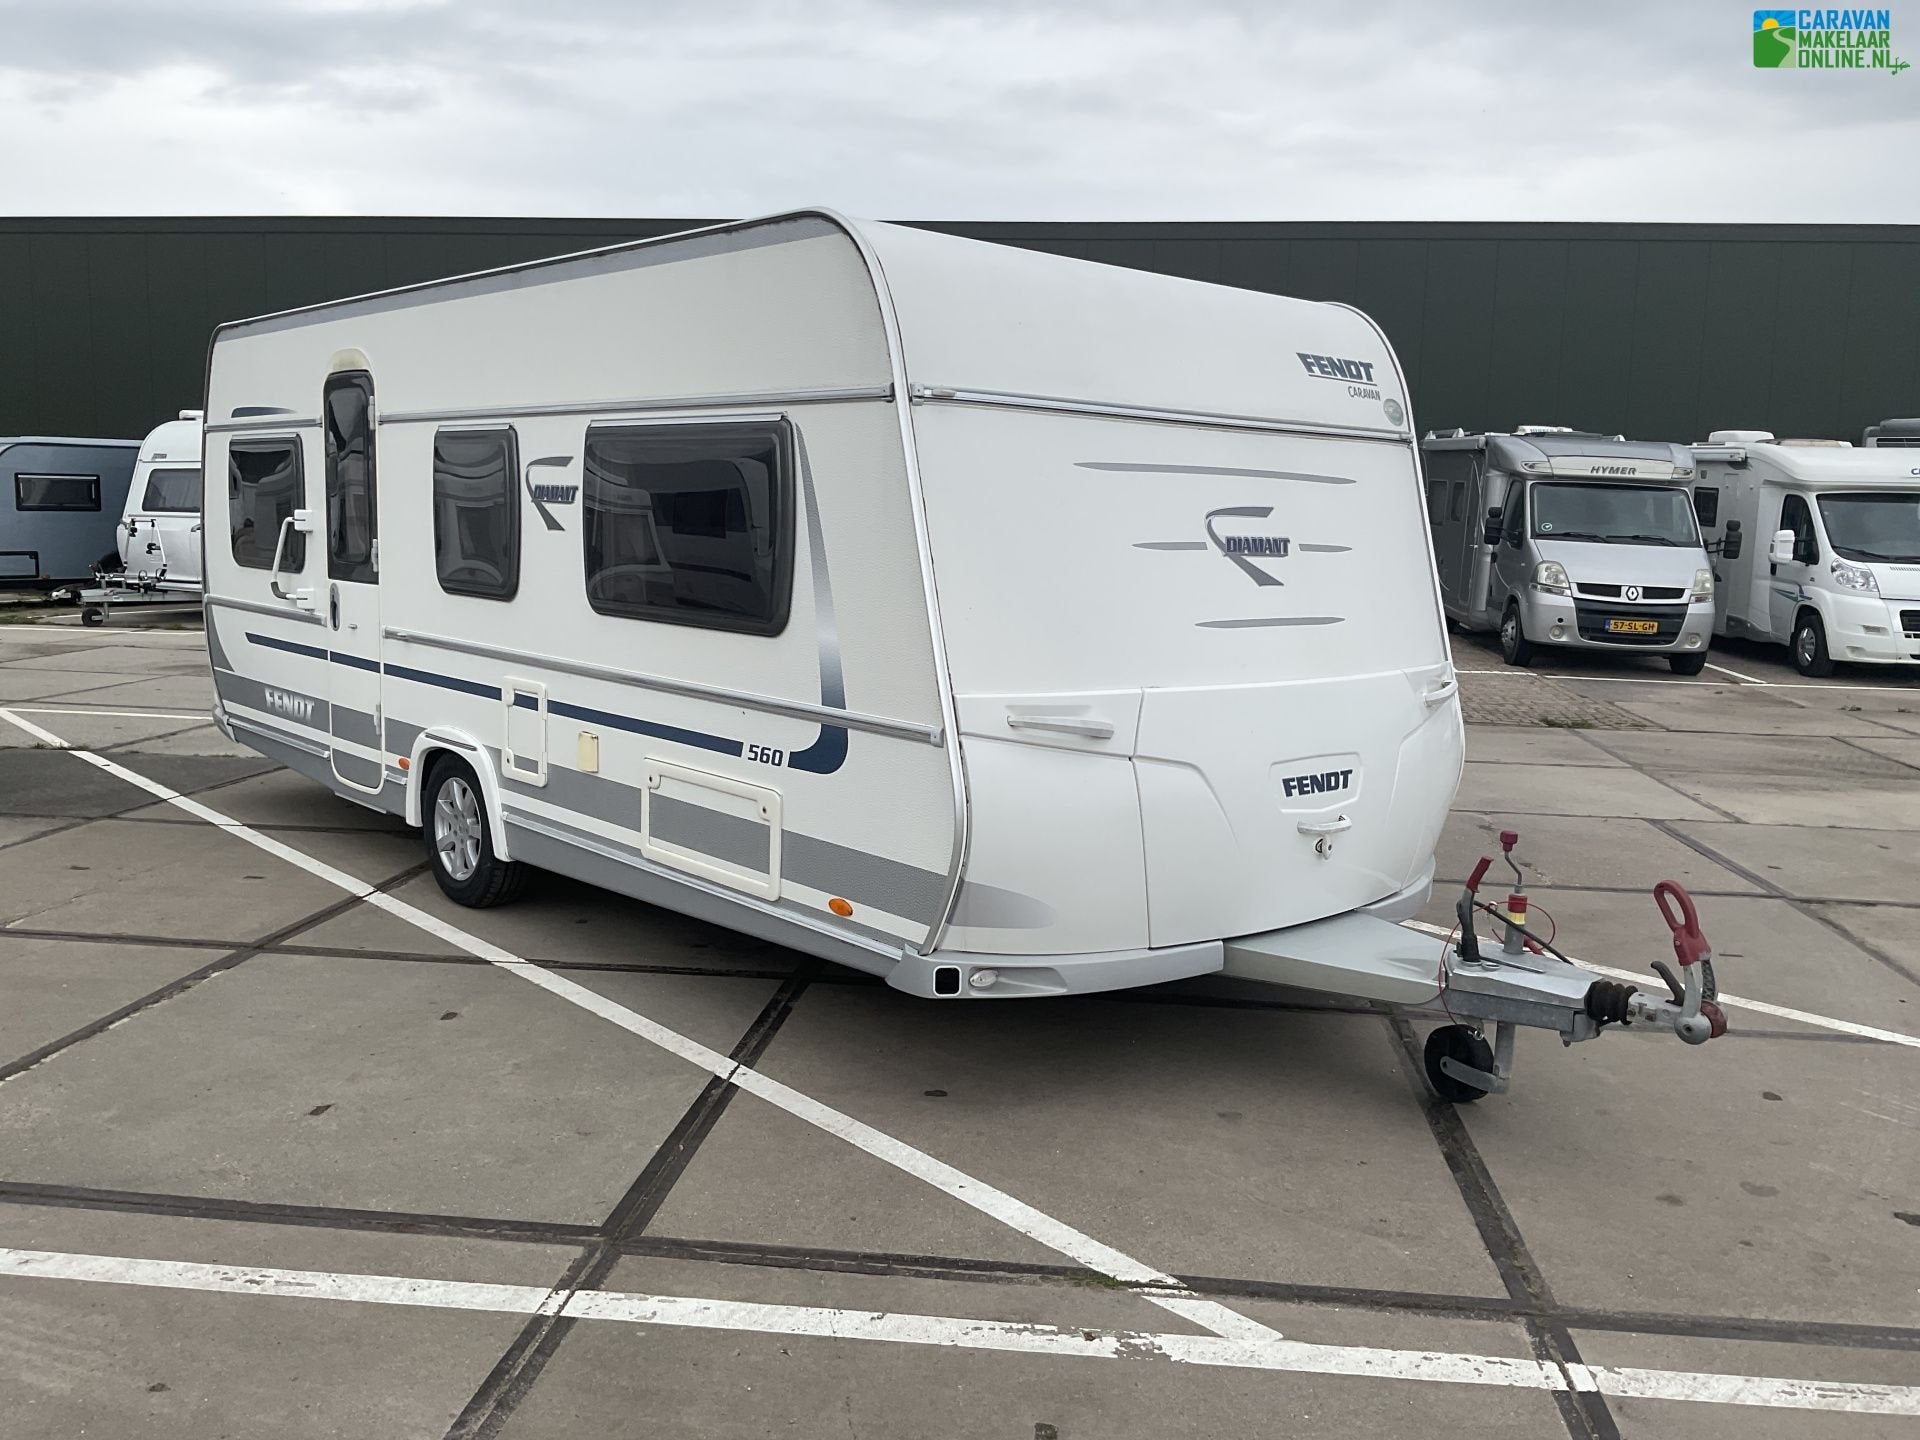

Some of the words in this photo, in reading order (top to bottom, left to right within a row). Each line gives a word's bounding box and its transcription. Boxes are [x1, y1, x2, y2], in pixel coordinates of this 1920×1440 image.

[1296, 352, 1375, 383] FENDT
[1347, 386, 1381, 401] CARAVAN
[1590, 465, 1637, 476] HYMER
[534, 484, 579, 503] DIAMANT
[1225, 535, 1290, 555] DIAMANT
[264, 687, 315, 721] FENDT
[747, 743, 784, 767] 560
[1281, 768, 1354, 798] FENDT
